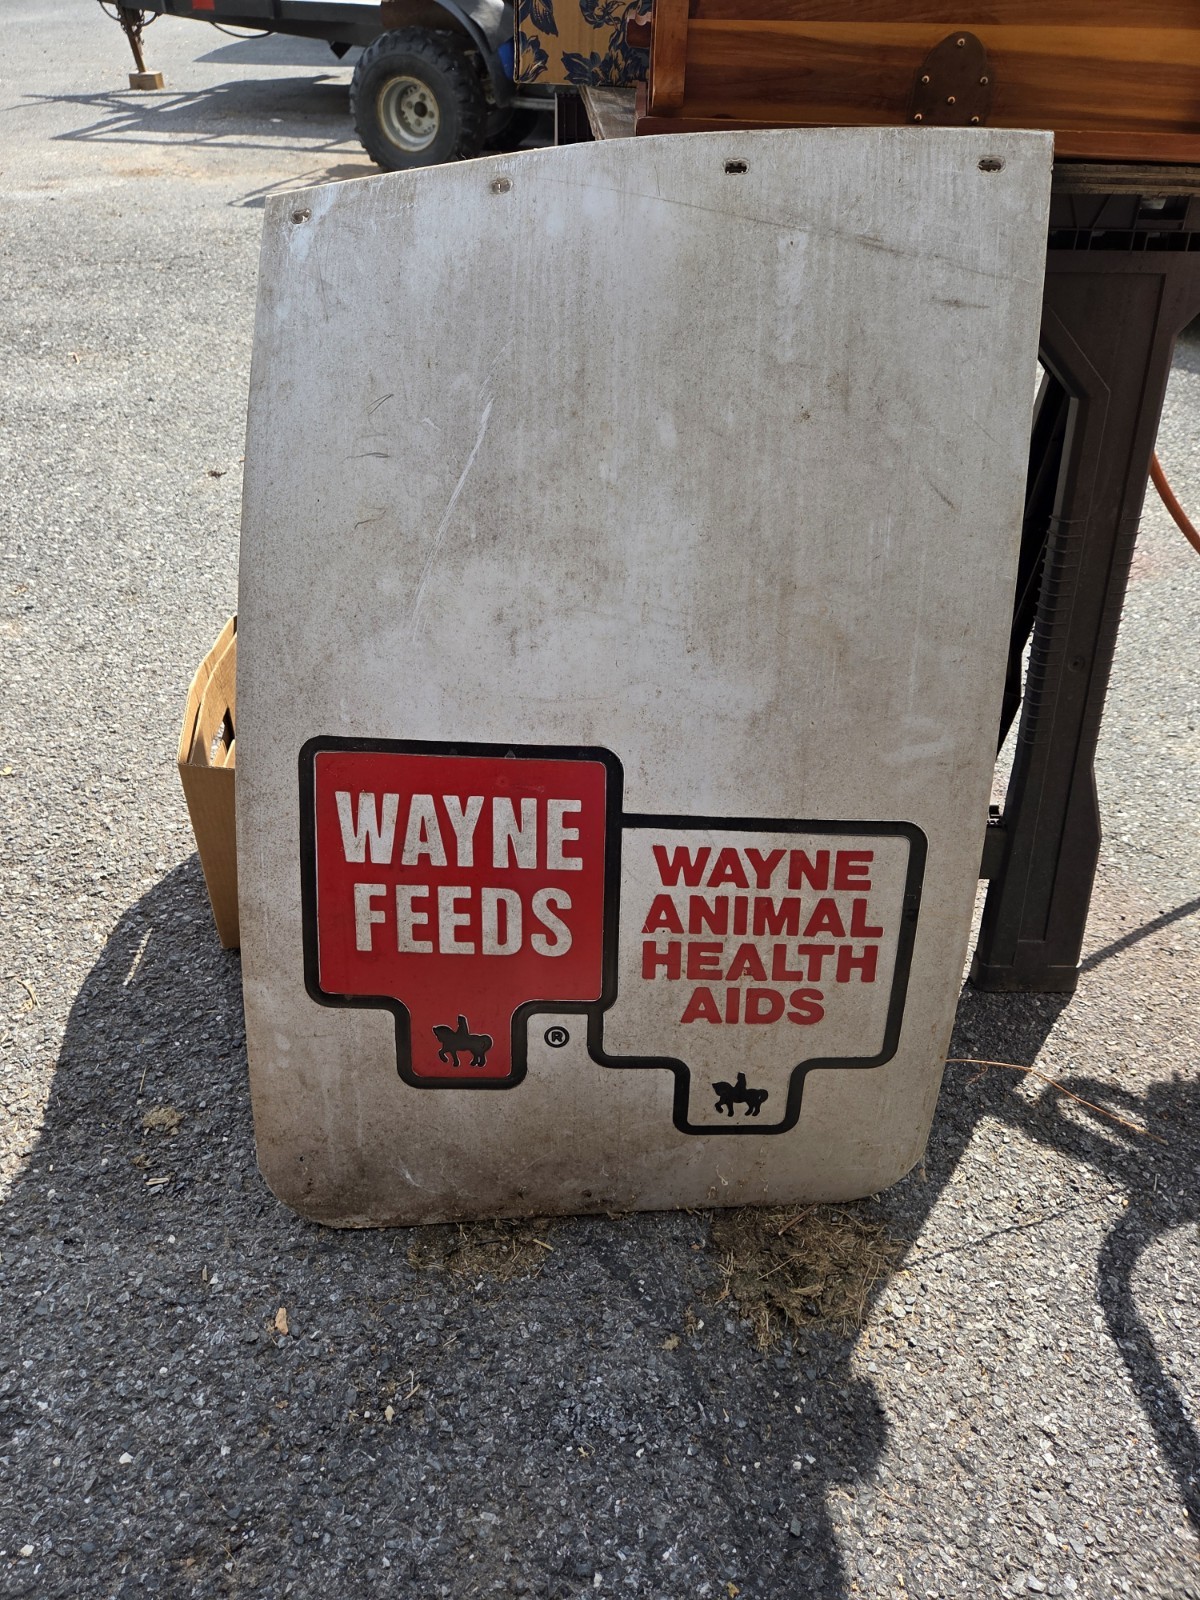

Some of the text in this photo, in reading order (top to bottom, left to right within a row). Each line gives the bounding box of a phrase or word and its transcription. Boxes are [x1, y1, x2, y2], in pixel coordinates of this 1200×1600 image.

[335, 791, 583, 870] WAYNE
[653, 845, 874, 891] WAYNE
[354, 884, 572, 957] FEEDS
[642, 894, 883, 937] ANIMAL
[643, 942, 878, 982] HEALTH
[681, 987, 825, 1025] AIDS
